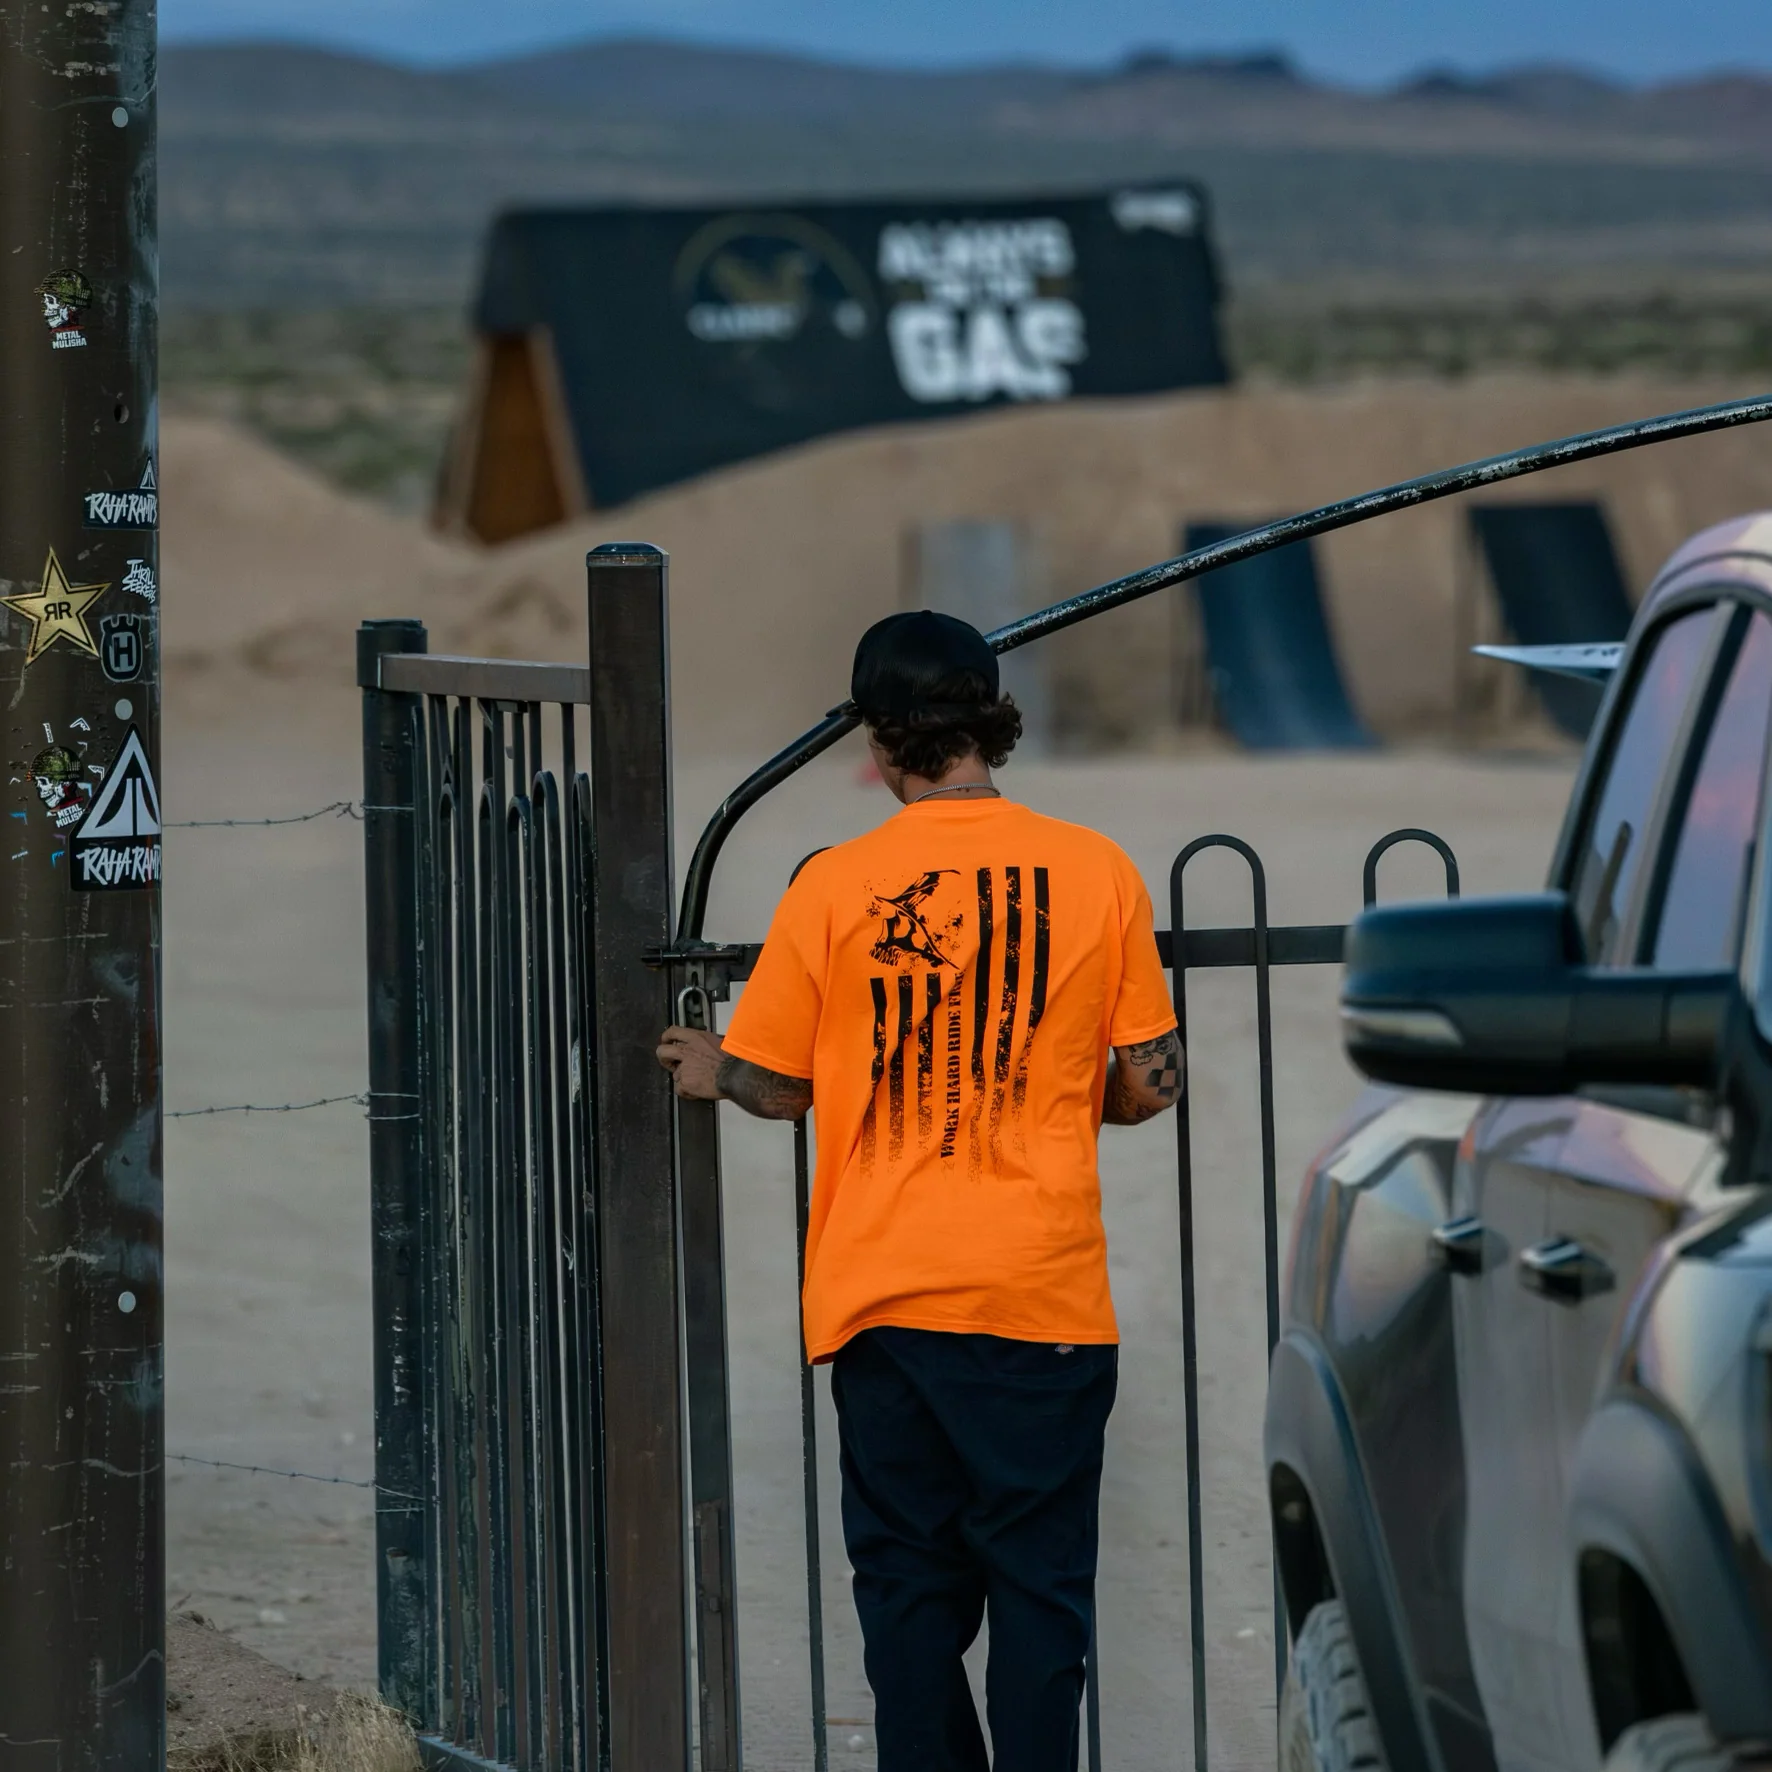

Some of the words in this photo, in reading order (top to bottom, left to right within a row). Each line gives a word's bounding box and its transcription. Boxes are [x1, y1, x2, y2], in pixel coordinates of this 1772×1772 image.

[52, 337, 87, 349] MULISHA
[55, 330, 81, 341] METAL
[888, 300, 1087, 403] GAS
[55, 808, 86, 828] MULISH
[57, 803, 82, 819] METAL
[947, 1010, 961, 1052] RIDE
[946, 1054, 961, 1105] HARD
[940, 1107, 960, 1159] WORK
